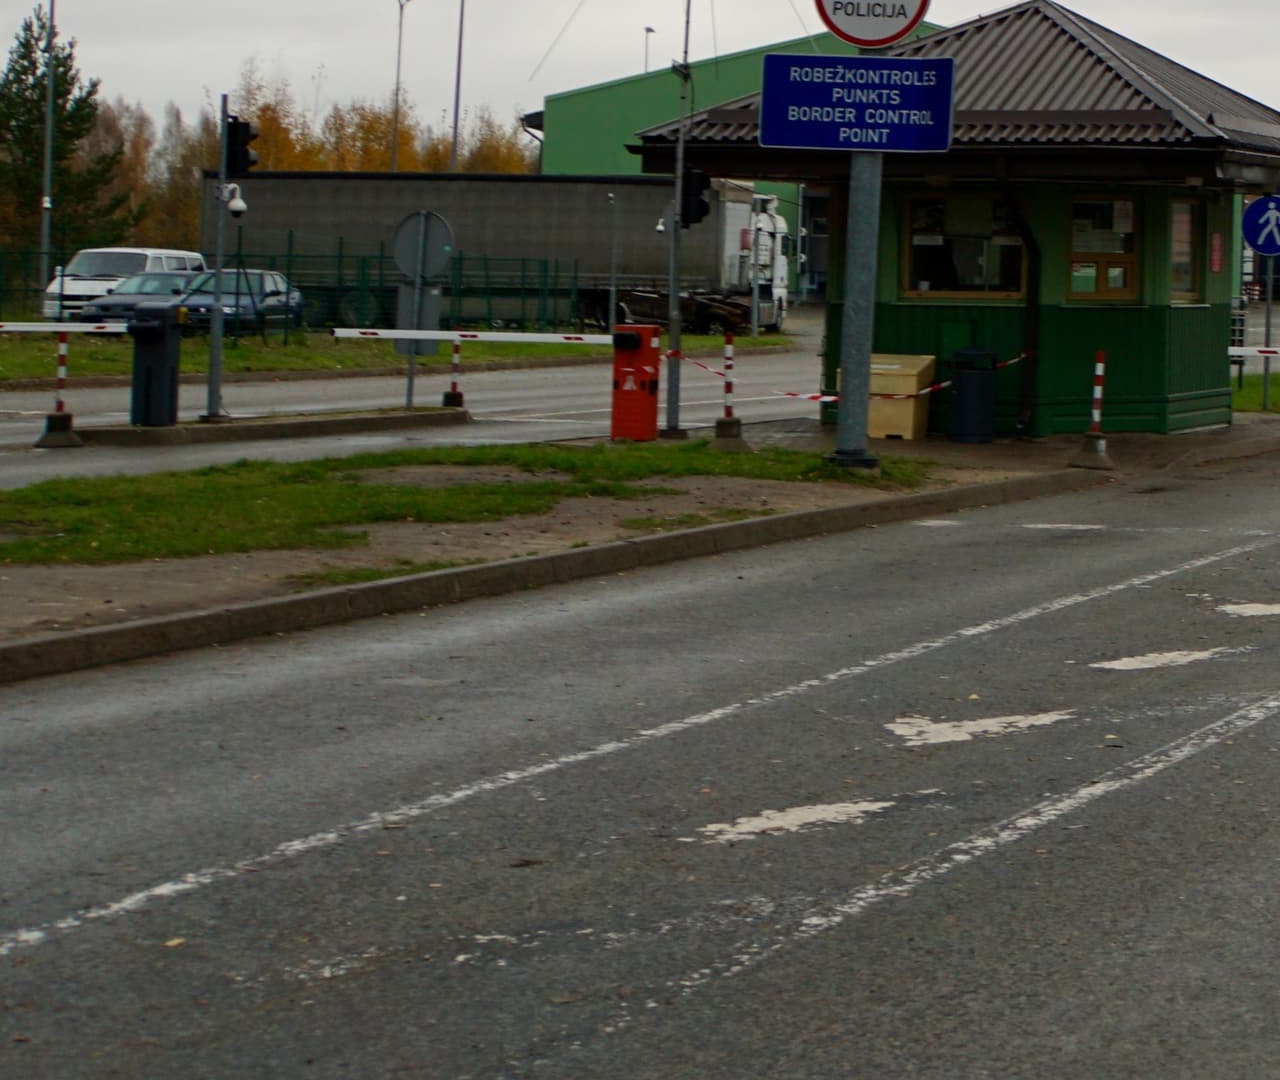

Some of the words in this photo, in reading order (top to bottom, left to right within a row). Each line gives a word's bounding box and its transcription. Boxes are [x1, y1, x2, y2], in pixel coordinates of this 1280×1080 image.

[832, 1, 908, 19] POLICIJA
[790, 65, 937, 86] ROBEŽKONTROLES
[832, 88, 901, 104] PUNKTS
[788, 106, 856, 123] BORDER
[865, 109, 934, 125] CONTROL
[839, 127, 890, 143] POINT
